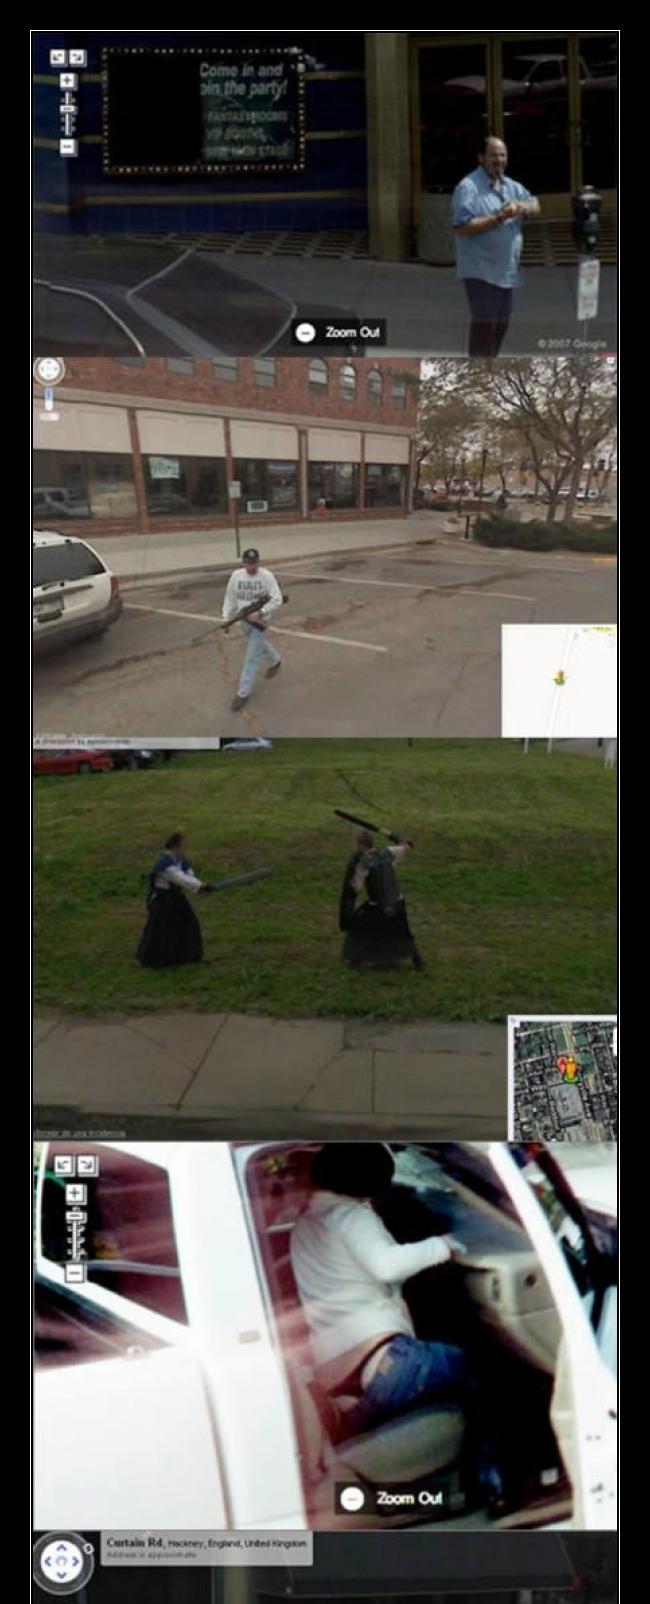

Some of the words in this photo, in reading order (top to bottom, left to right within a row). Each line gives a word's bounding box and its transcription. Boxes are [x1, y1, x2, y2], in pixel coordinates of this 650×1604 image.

[200, 62, 239, 77] Come
[242, 63, 255, 77] in
[258, 62, 283, 77] and
[223, 80, 246, 95] the
[248, 79, 288, 101] party!
